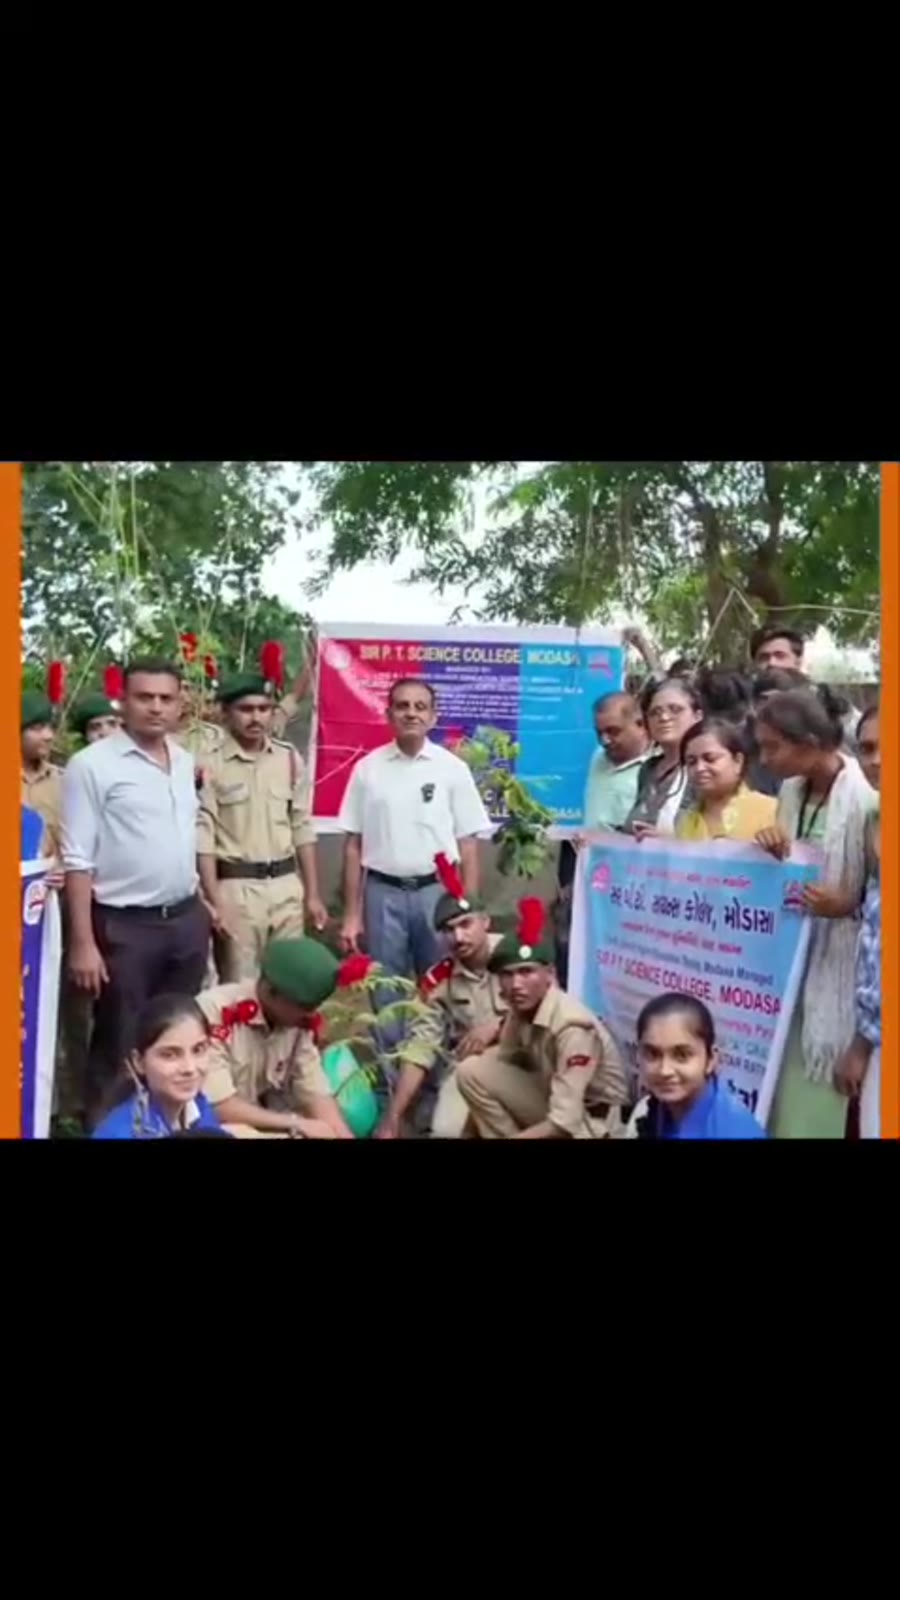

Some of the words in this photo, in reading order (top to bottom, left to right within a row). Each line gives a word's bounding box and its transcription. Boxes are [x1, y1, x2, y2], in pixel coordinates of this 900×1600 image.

[360, 645, 382, 660] SIR
[407, 647, 460, 662] SCIENCE
[526, 650, 580, 665] MODASA
[624, 957, 661, 985] SCIENCE
[720, 985, 782, 1017] MODASA
